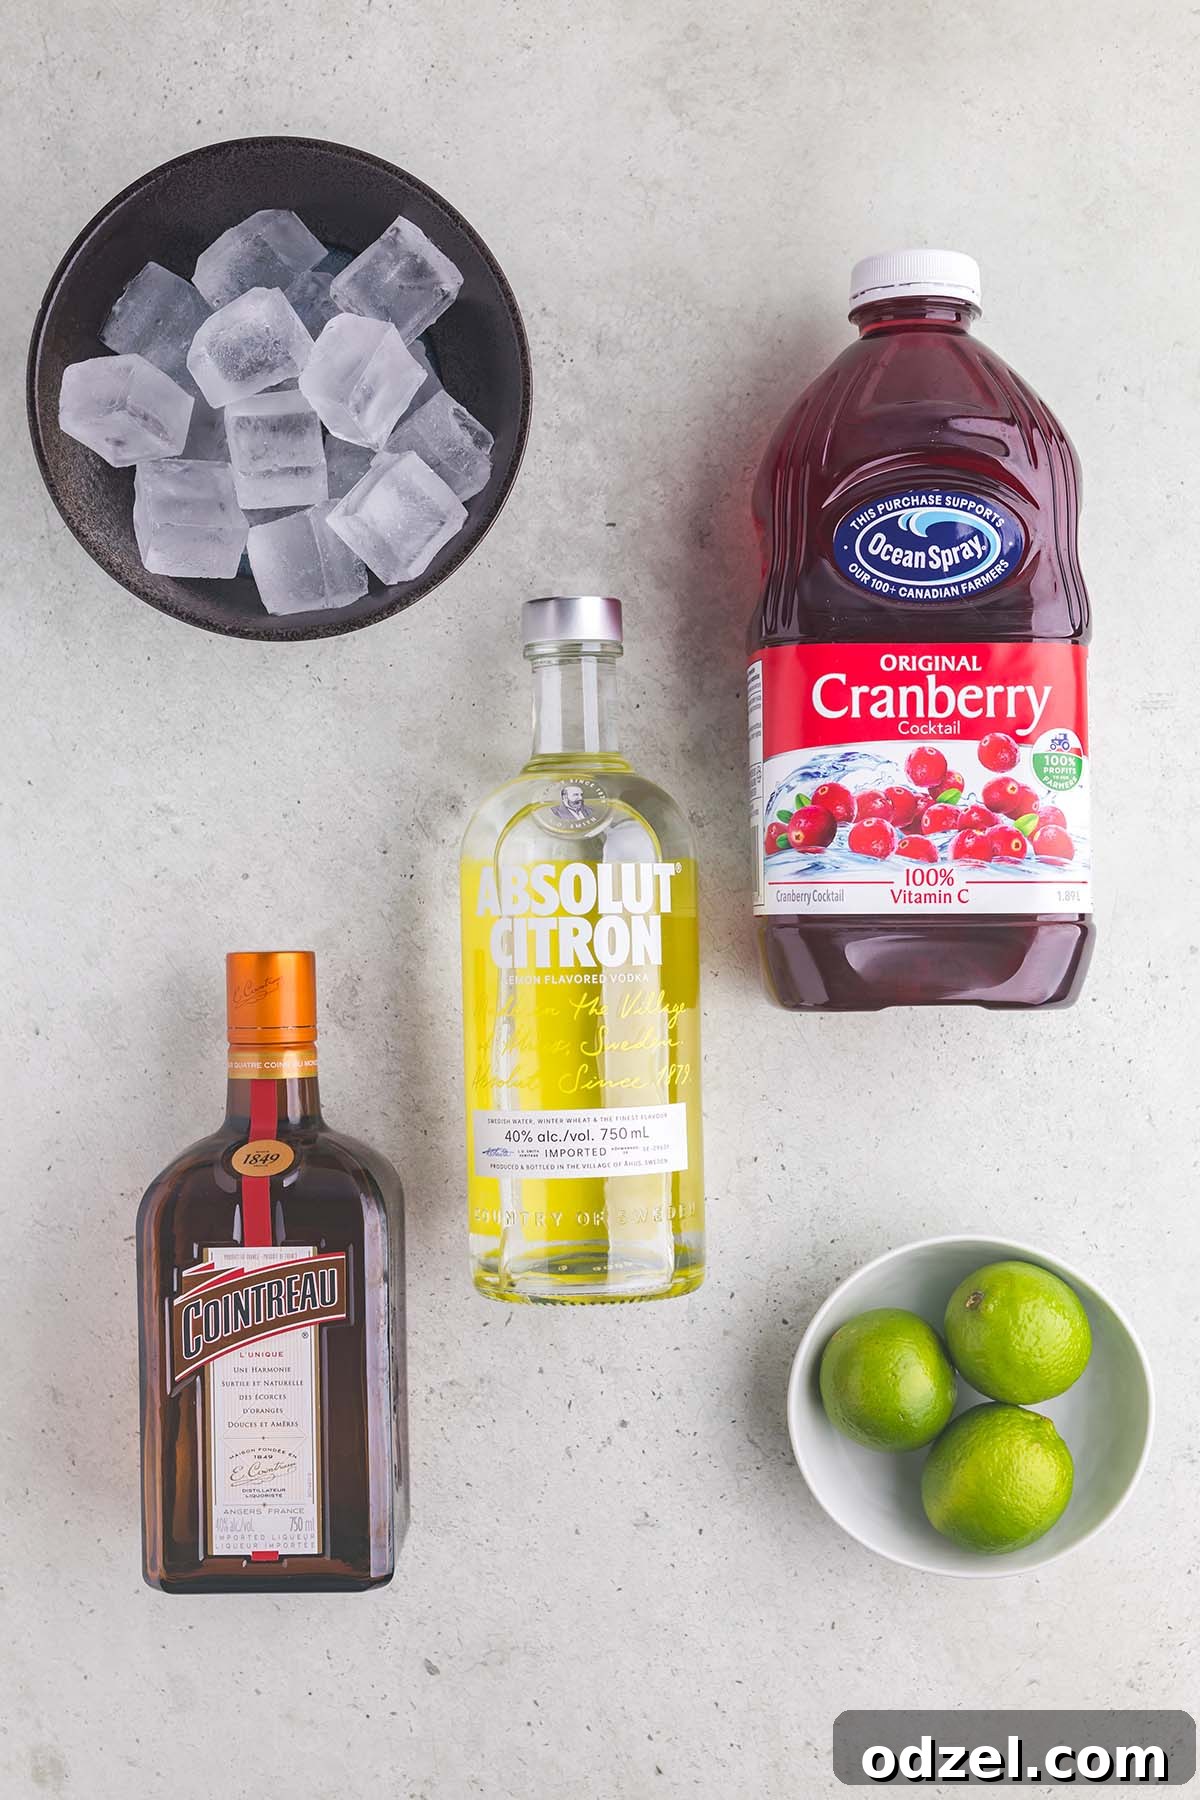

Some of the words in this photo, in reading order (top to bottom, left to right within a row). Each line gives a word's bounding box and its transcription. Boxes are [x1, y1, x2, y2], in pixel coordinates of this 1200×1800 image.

[850, 508, 877, 531] THIS
[877, 494, 942, 515] PURCHASE
[945, 496, 1005, 528] SUPPORTS
[867, 532, 926, 569] Ocean
[928, 534, 983, 572] Spray
[848, 563, 870, 585] OUR
[871, 578, 896, 594] 100+
[898, 585, 960, 599] CANADIAN
[961, 559, 1010, 595] FARMERS
[879, 654, 982, 672] ORIGINAL
[811, 673, 1053, 737] Cranberry
[897, 720, 961, 735] Cocktail
[1043, 754, 1076, 767] 100%
[1043, 767, 1077, 775] PROFITS
[905, 868, 955, 887] 100%
[476, 862, 677, 918] ABSOLUT
[776, 889, 812, 905] Cranberry
[812, 889, 845, 902] Cocktail
[890, 889, 952, 904] Vitamin
[957, 889, 970, 904] C
[490, 915, 662, 969] CITRON
[504, 975, 541, 985] LEMON
[544, 974, 606, 985] FLAVORED
[610, 973, 649, 984] VODKA
[568, 992, 609, 1021] the
[620, 990, 687, 1029] Village
[558, 1063, 647, 1094] Since
[504, 1129, 533, 1143] 40%
[537, 1128, 595, 1143] alc./vol.
[600, 1126, 628, 1141] 750
[630, 1125, 650, 1139] mL
[243, 1153, 280, 1165] 1849
[544, 1147, 607, 1158] IMPORTED
[581, 1161, 611, 1169] VILLAGE
[182, 1268, 337, 1360] COINTREAU
[229, 1448, 255, 1459] MAISON
[290, 1516, 303, 1532] 750
[305, 1517, 315, 1532] ml
